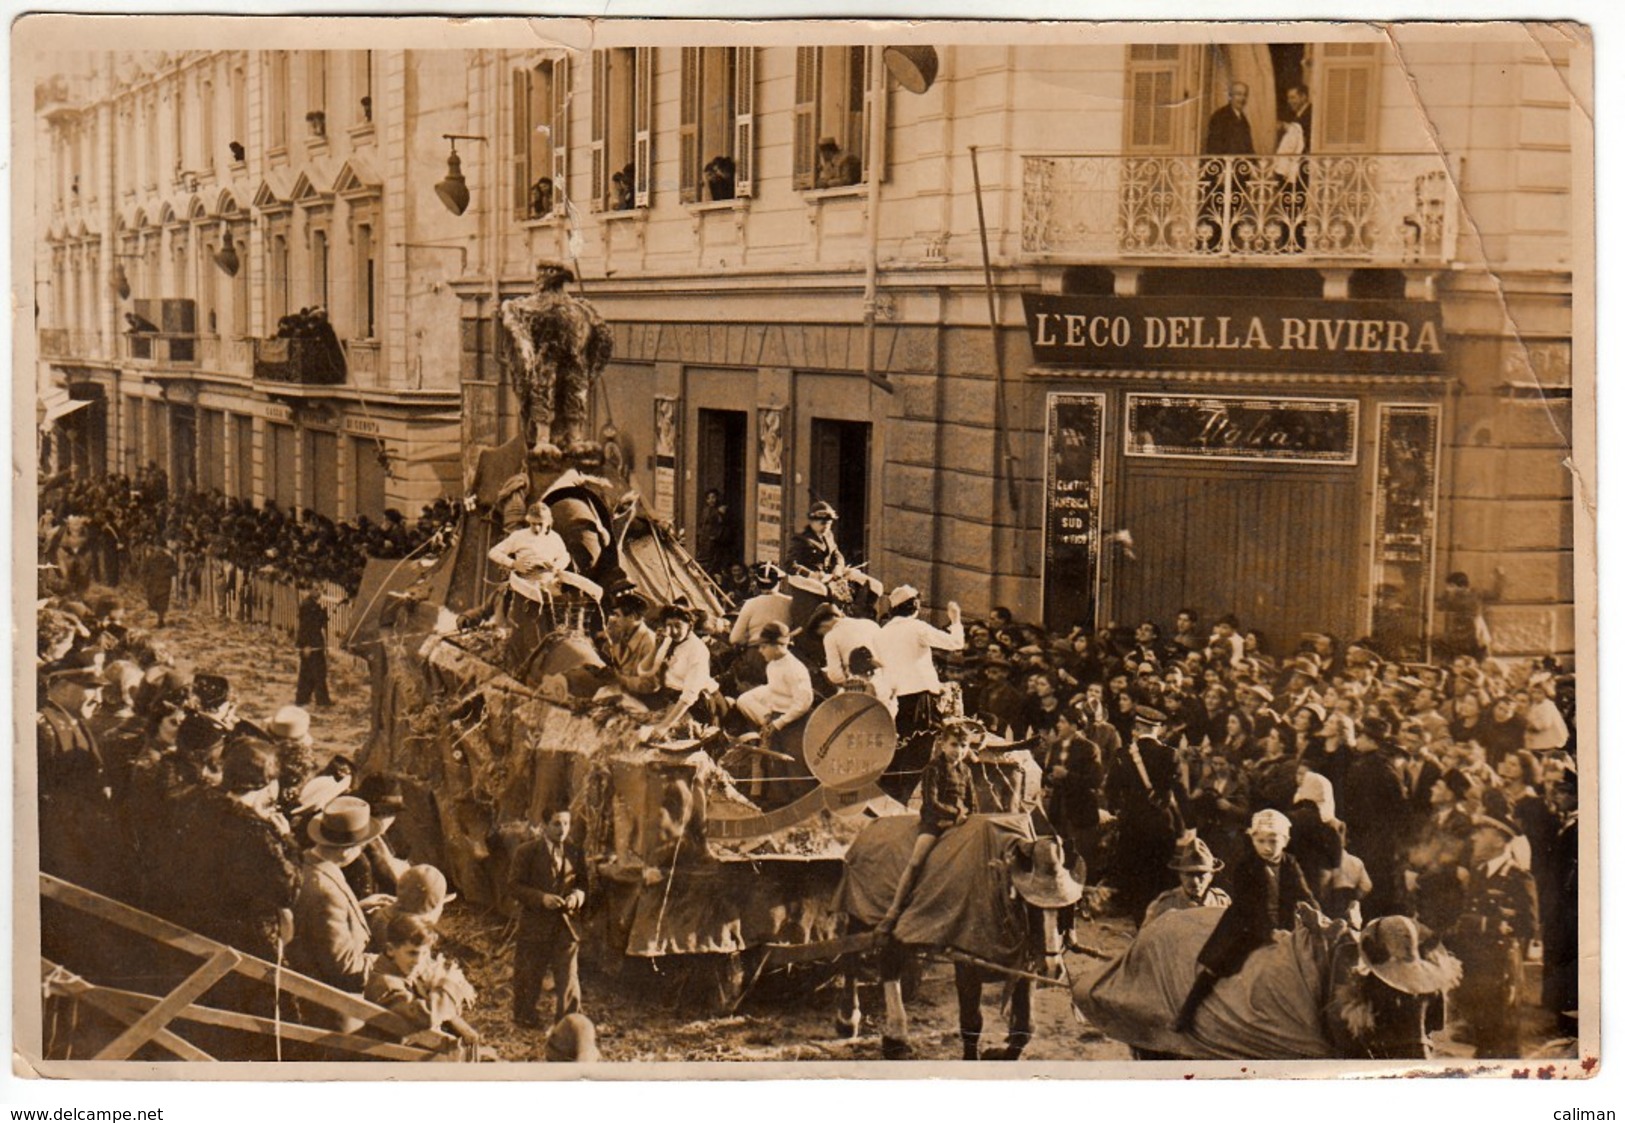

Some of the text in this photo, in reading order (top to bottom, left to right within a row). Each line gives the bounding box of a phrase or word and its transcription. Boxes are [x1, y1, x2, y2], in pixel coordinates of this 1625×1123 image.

[1035, 313, 1442, 354] L'ECO DELLA RIVIERA
[1062, 517, 1083, 529] SUD
